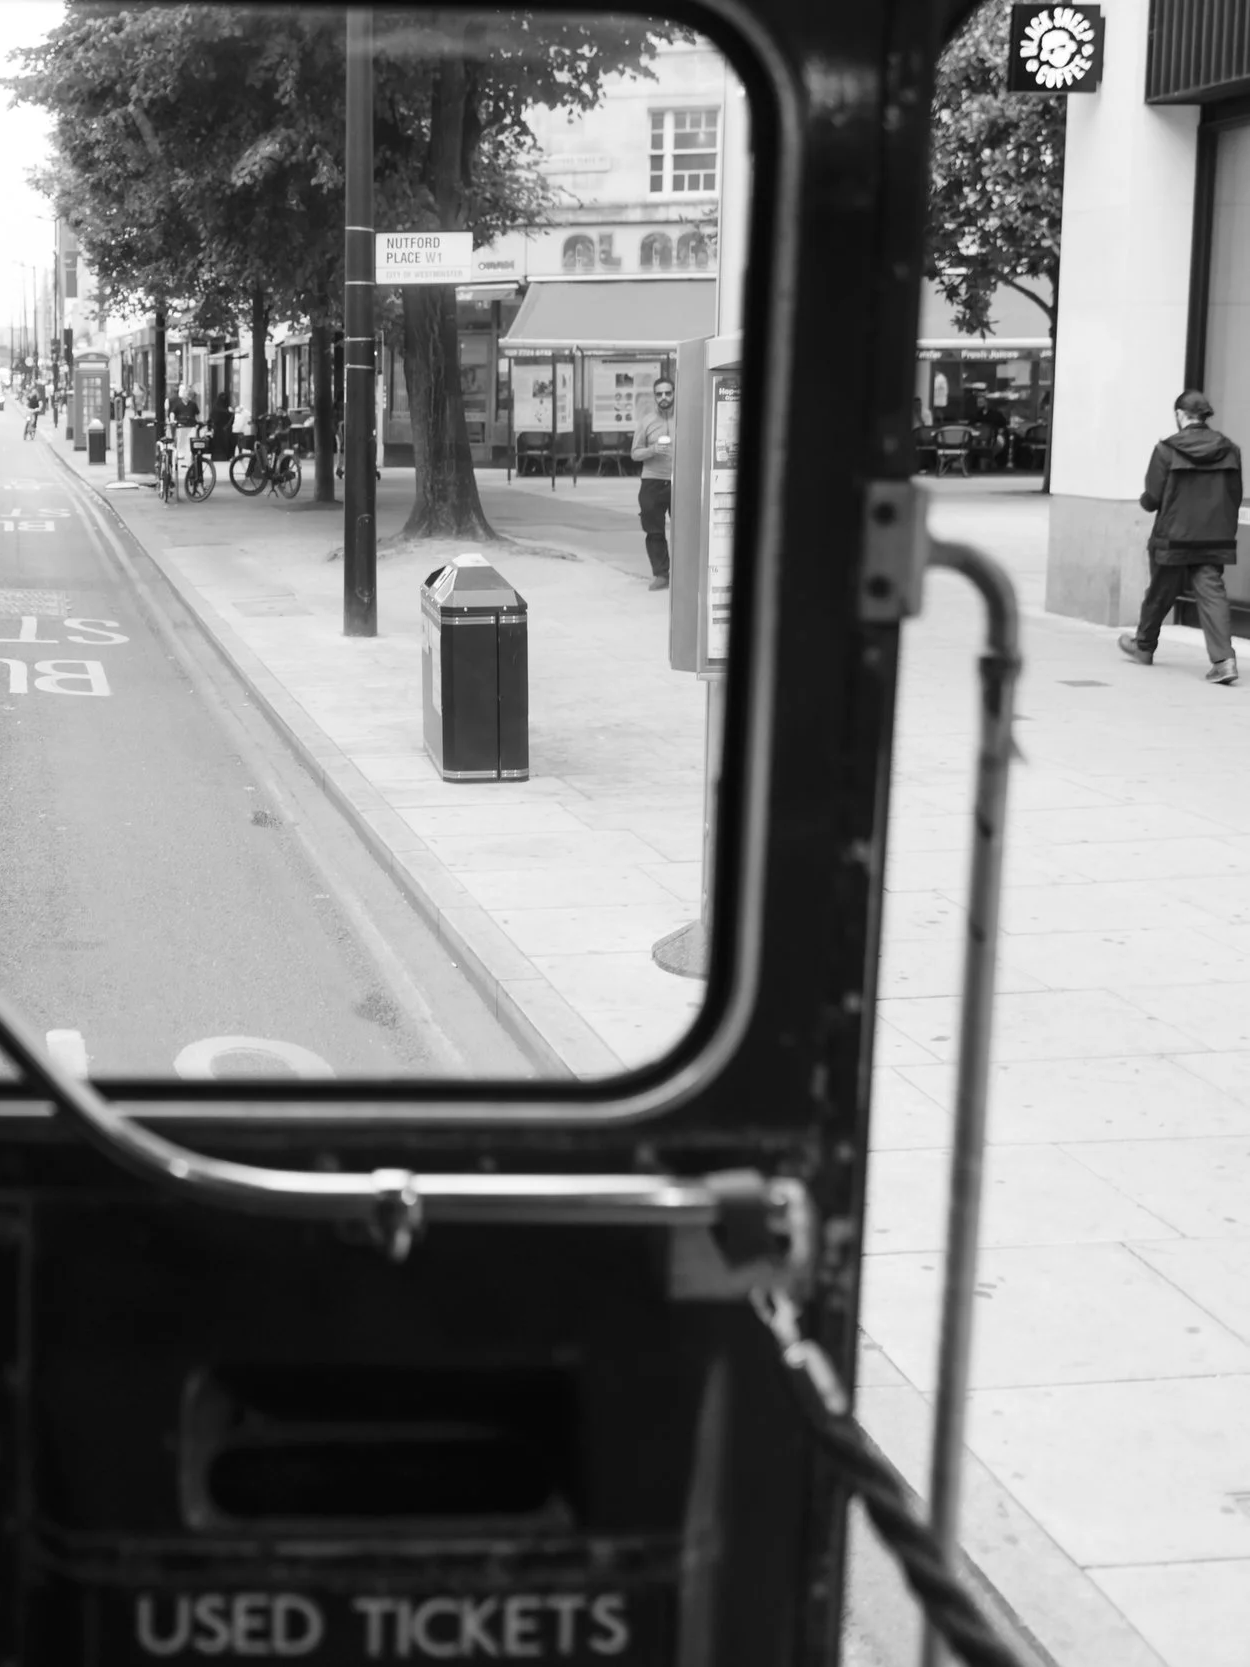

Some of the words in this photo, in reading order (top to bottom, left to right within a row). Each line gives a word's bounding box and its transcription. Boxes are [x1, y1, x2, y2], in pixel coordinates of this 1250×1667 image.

[1019, 10, 1054, 58] BLACK
[1053, 7, 1095, 42] SHEEP
[1035, 54, 1093, 89] COFFEE
[386, 237, 441, 249] NUTFORD
[386, 252, 422, 264] PLACE
[425, 252, 443, 263] W1
[136, 1594, 324, 1657] USED
[354, 1594, 630, 1658] TICKETS
